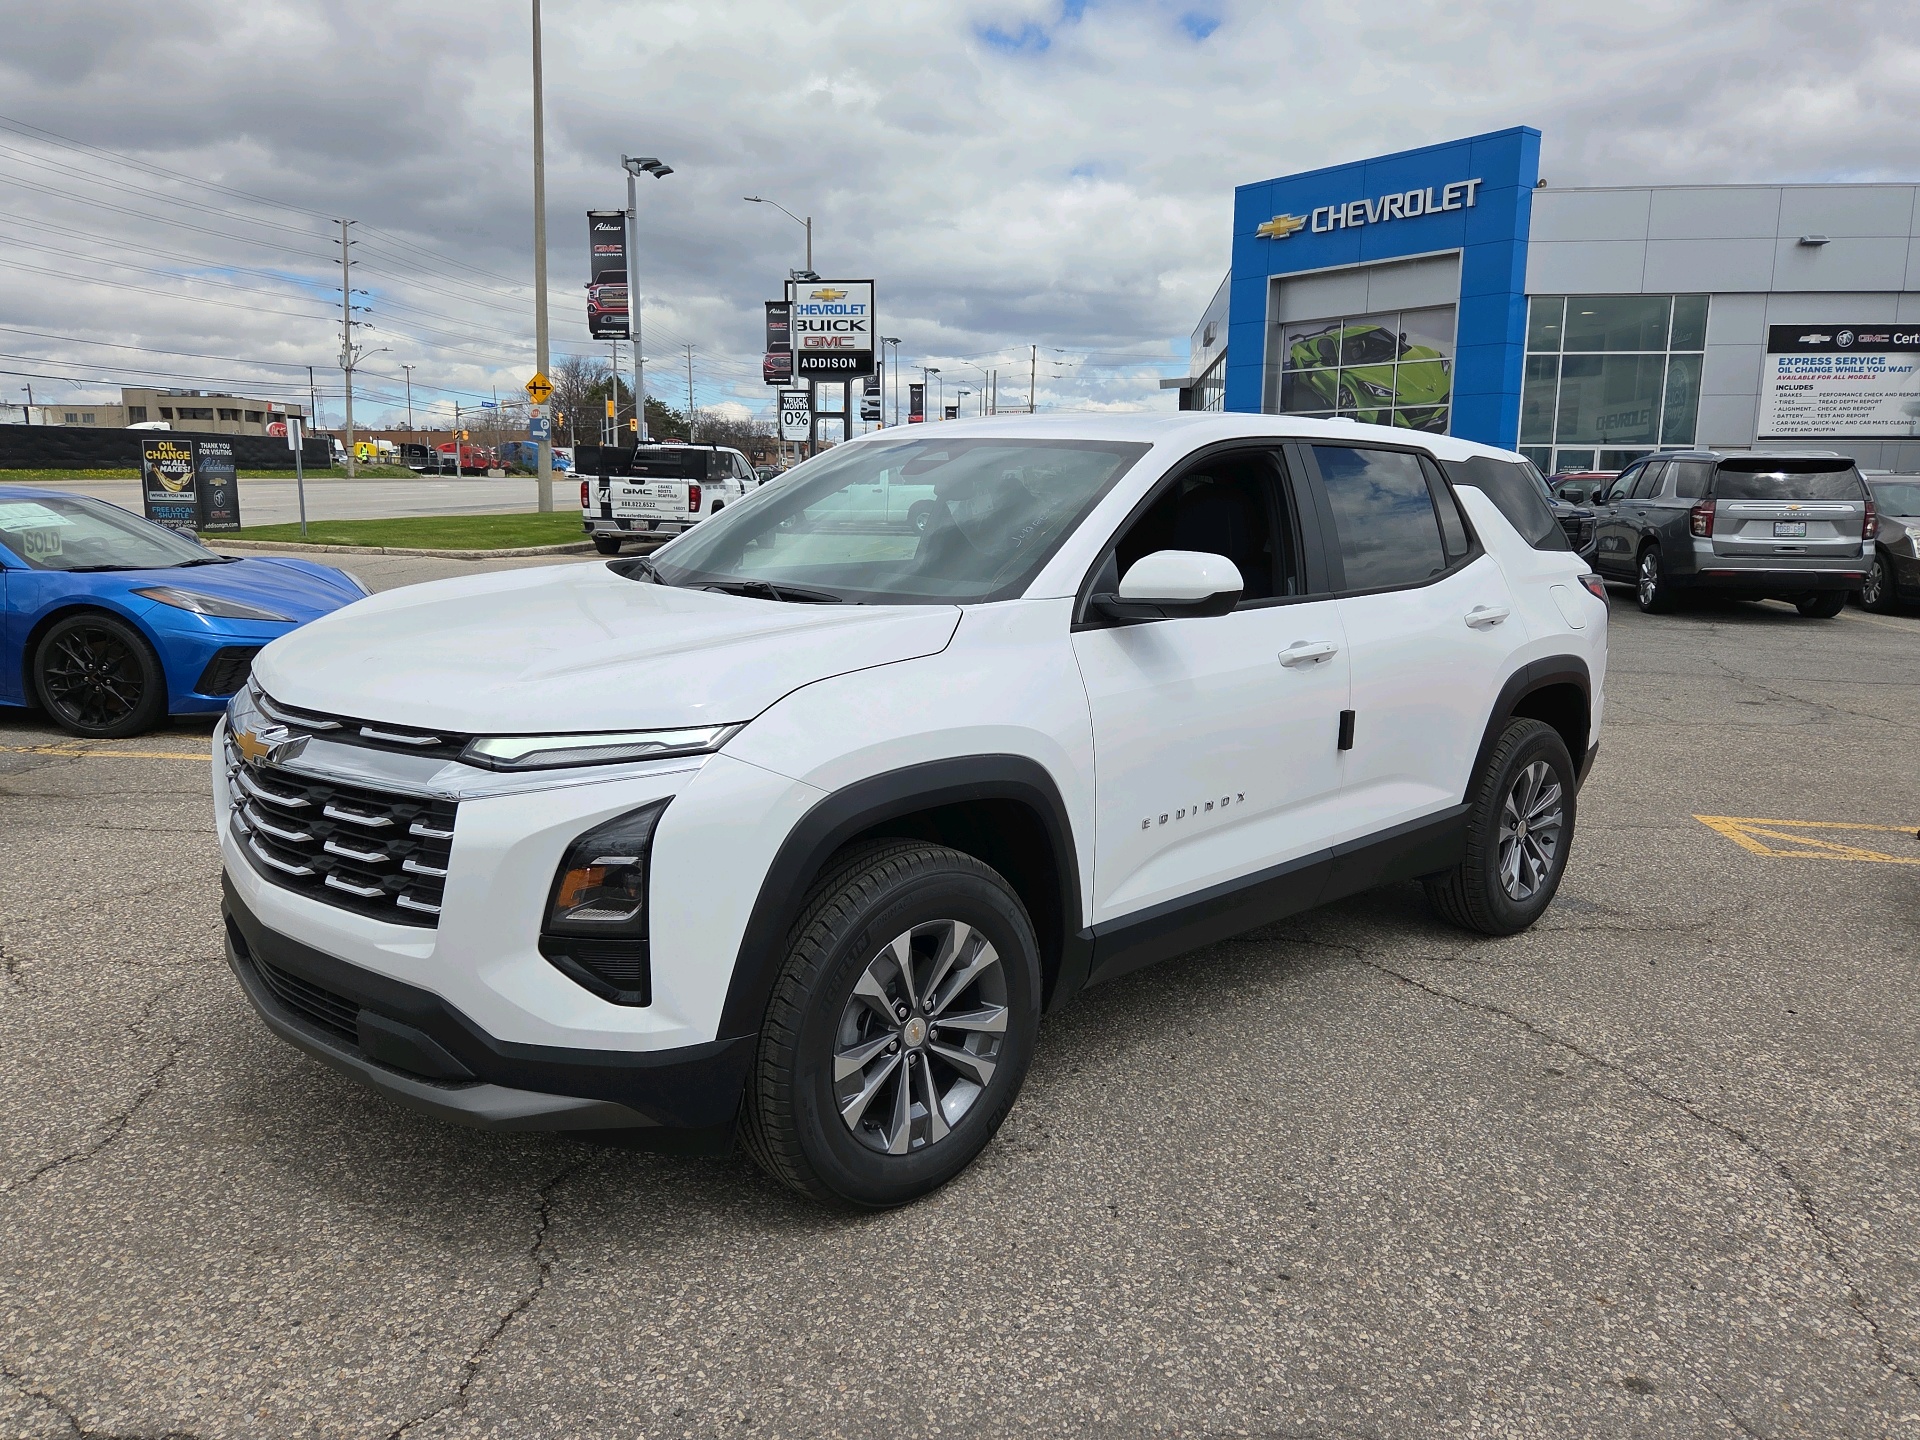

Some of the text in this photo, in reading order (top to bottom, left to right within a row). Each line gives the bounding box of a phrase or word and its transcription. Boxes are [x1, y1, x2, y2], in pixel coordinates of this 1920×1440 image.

[1311, 178, 1483, 233] CHEVROLET
[594, 223, 621, 231] Addison
[594, 244, 622, 252] GMC
[804, 336, 854, 348] GMC
[1858, 334, 1890, 343] GMC
[801, 358, 857, 368] ADDISON
[1778, 357, 1886, 366] EXPRESS SERVICE
[784, 412, 808, 425] 0%
[158, 442, 176, 451] OIL
[145, 451, 190, 459] CHANGE
[199, 457, 235, 472] Addison
[25, 531, 60, 553] SOLD
[1142, 792, 1245, 829] EQUINOX
